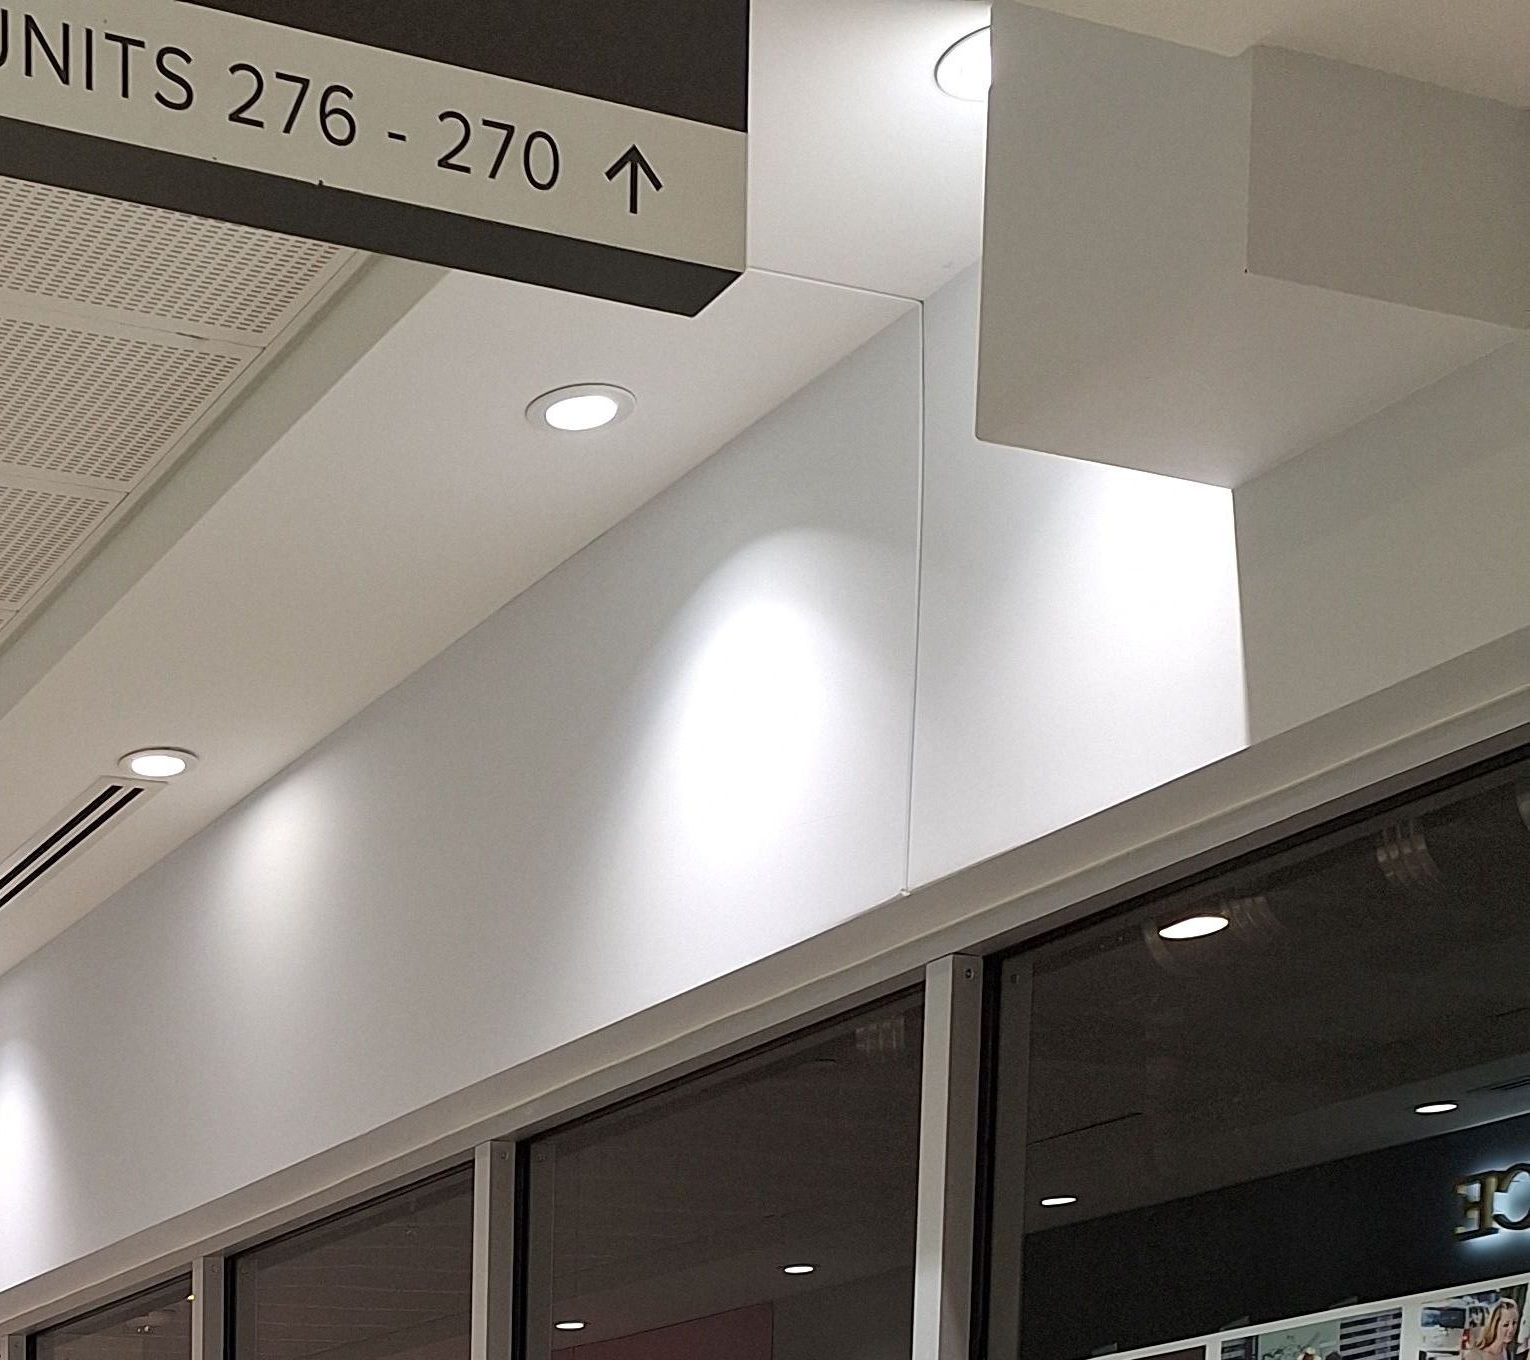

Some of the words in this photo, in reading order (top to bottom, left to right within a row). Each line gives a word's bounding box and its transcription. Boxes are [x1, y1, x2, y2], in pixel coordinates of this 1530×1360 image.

[228, 62, 358, 147] 276
[386, 130, 407, 143] -
[437, 110, 560, 191] 270
